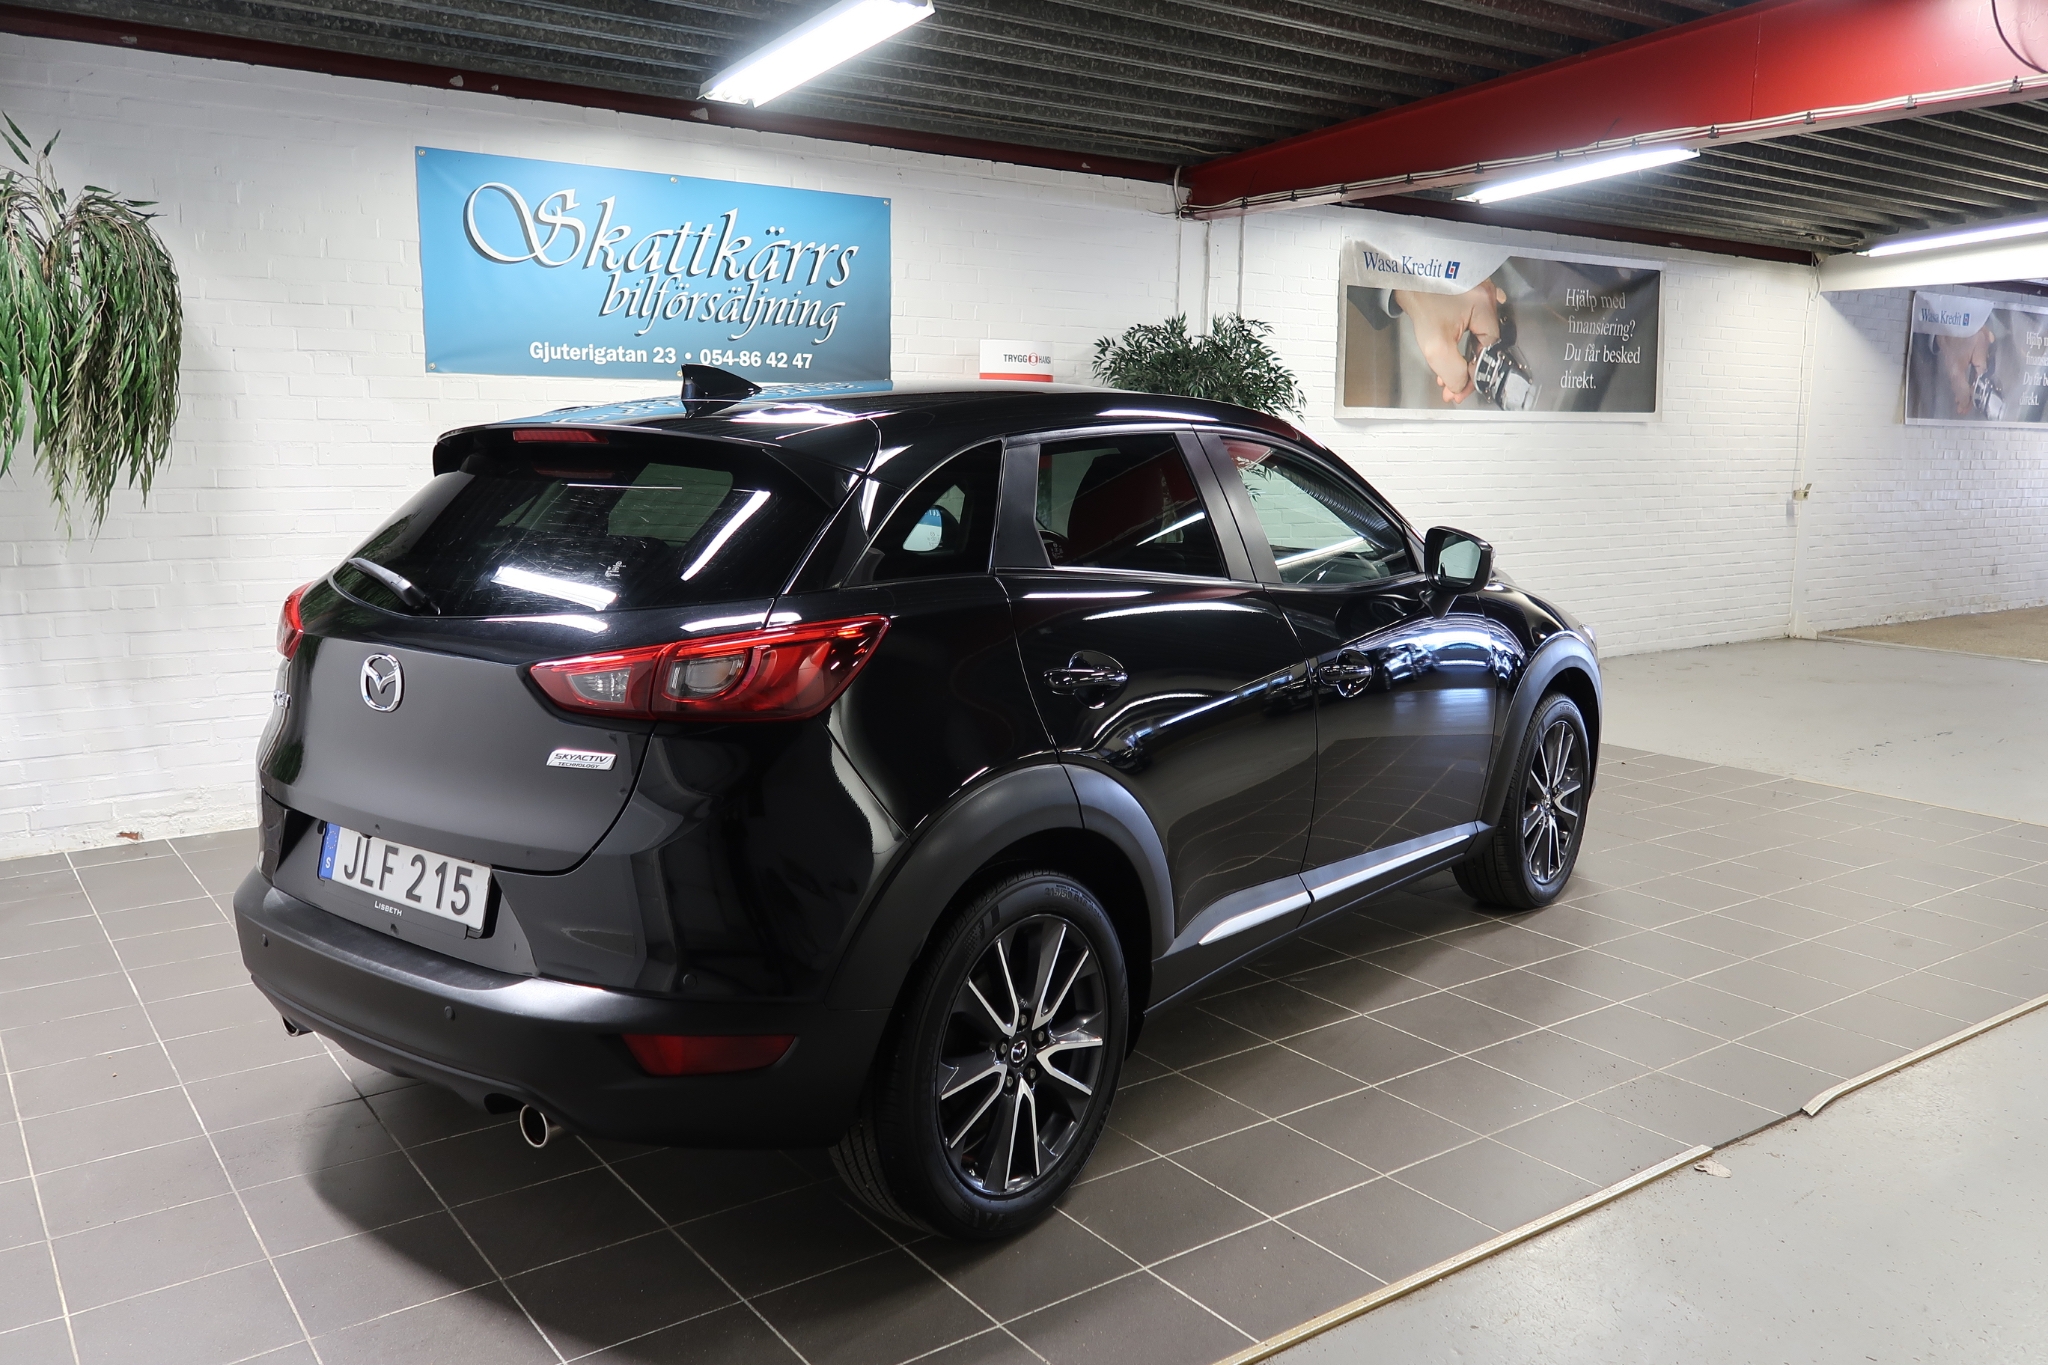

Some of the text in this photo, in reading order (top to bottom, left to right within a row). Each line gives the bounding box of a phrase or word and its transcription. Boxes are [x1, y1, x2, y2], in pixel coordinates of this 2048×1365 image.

[464, 182, 859, 287] Skattkärrs
[1363, 251, 1443, 278] Wasa Kredit
[599, 270, 846, 345] bilförsäljning
[1565, 288, 1626, 312] Hjälp med
[1568, 315, 1636, 341] finansiering?
[1940, 310, 1961, 325] Kredit
[529, 341, 813, 369] Gjuterigatan 23 054-86 42 47
[1003, 354, 1027, 363] TRYGG
[1564, 343, 1641, 364] Du får besked
[1560, 370, 1597, 389] direkt.
[555, 753, 608, 762] SKYACTIV
[558, 761, 600, 769] TECHNOLOGY
[325, 836, 474, 916] S JLF 215
